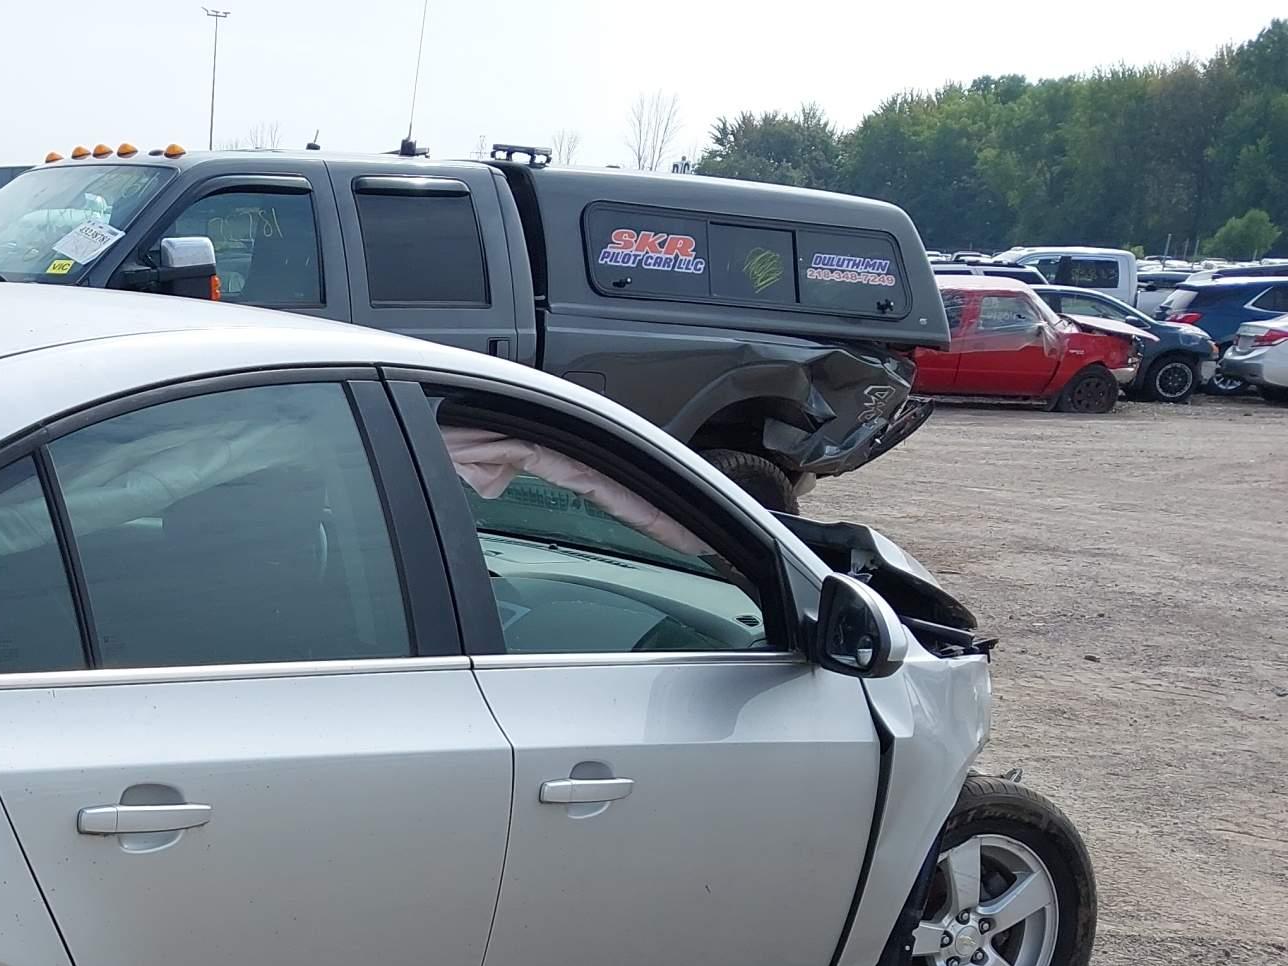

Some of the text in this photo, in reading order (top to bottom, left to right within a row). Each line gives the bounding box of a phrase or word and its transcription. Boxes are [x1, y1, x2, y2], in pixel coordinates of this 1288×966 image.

[607, 229, 697, 258] SKR
[51, 262, 71, 271] VIC
[599, 248, 706, 274] PILOT CAR LLC
[806, 268, 896, 287] 218-348-7249
